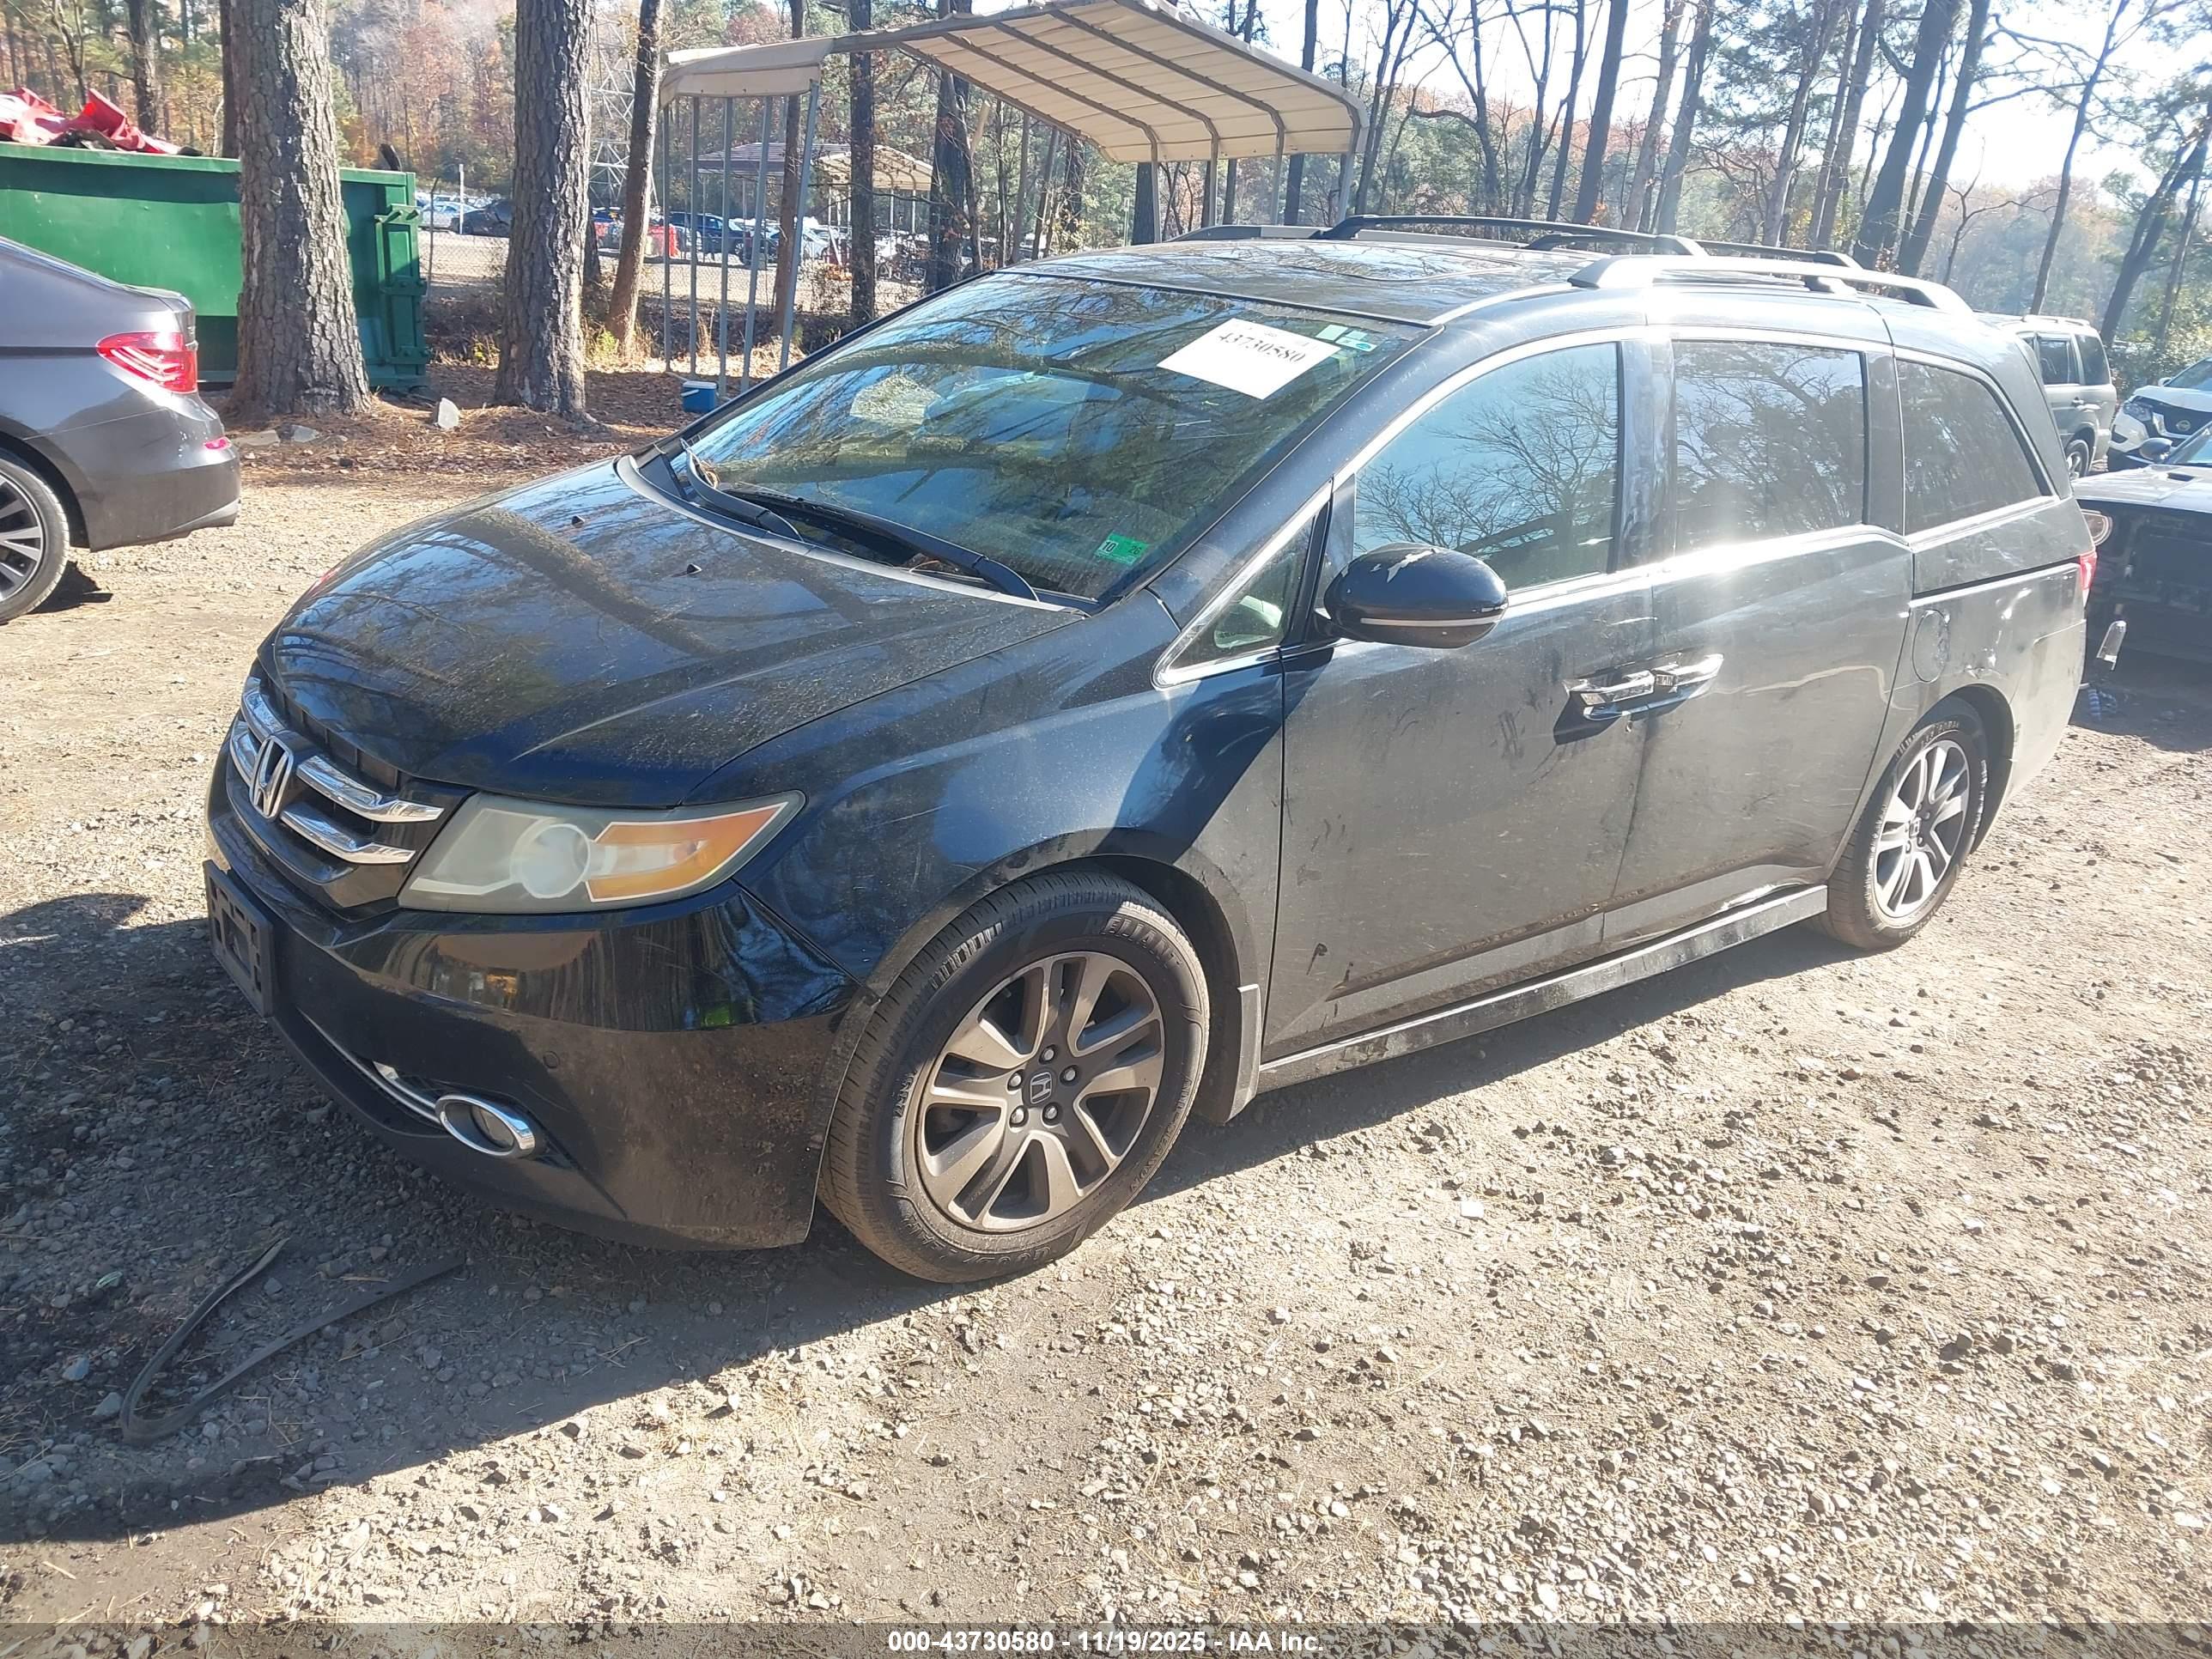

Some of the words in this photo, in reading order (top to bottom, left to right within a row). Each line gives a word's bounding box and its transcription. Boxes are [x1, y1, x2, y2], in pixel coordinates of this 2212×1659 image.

[1218, 331, 1306, 362] 43730580
[1102, 541, 1117, 552] 10
[1128, 545, 1142, 555] 26
